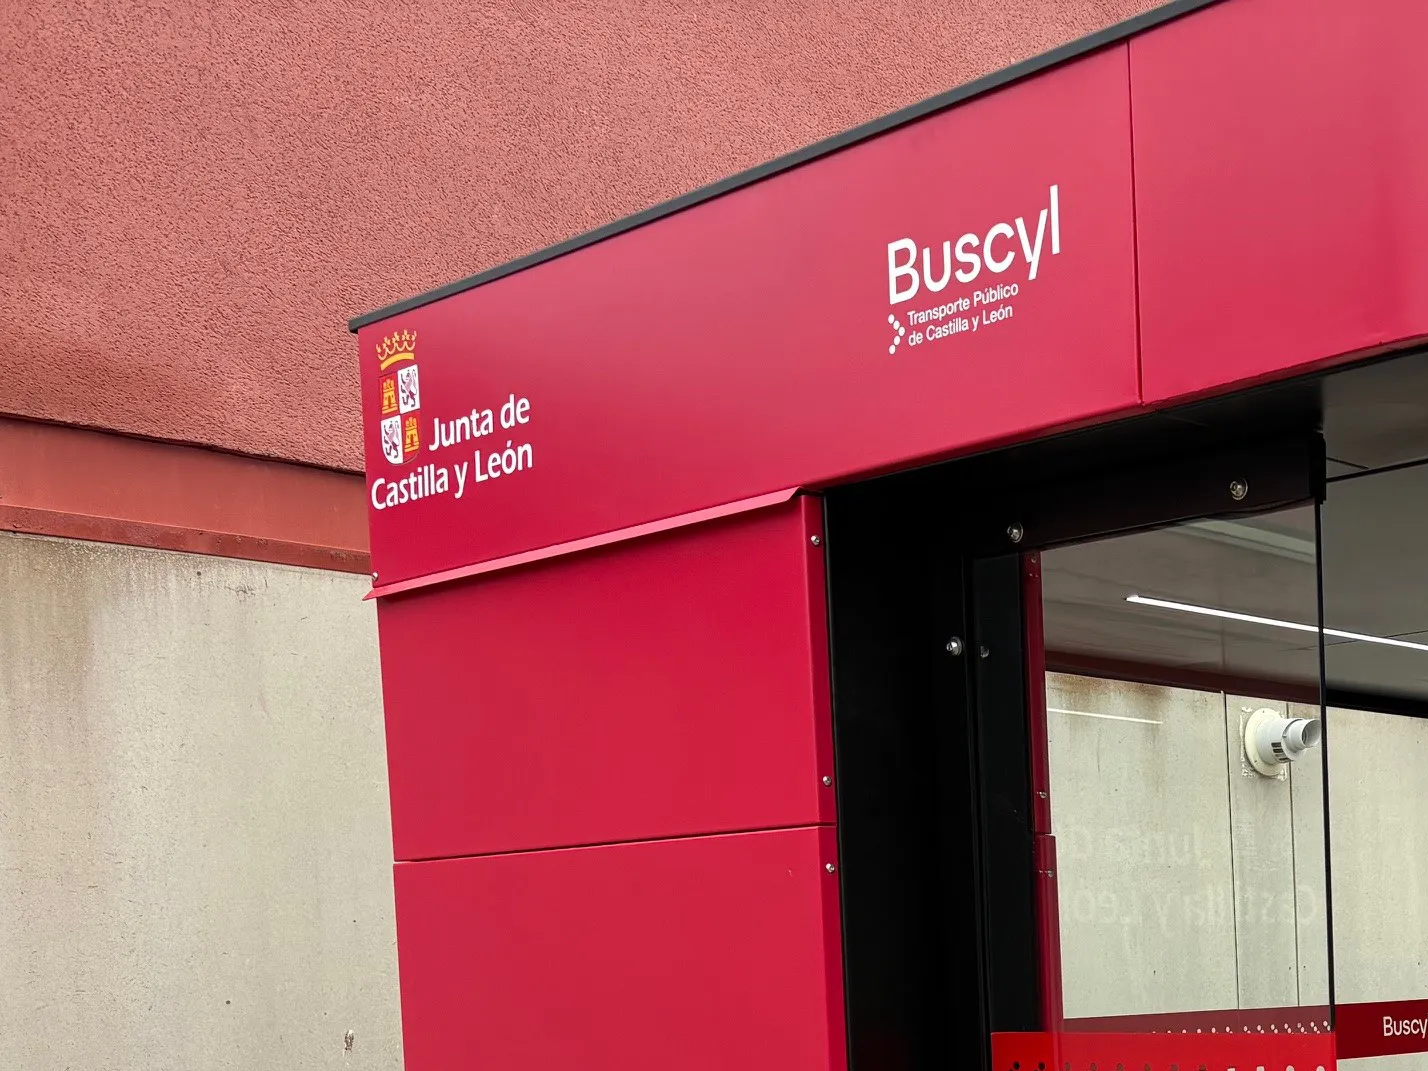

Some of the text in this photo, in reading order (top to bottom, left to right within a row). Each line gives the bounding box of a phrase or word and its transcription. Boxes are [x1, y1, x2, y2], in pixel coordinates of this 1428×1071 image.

[888, 184, 1060, 305] Buscyl
[907, 283, 1019, 326] Transporte Público
[908, 304, 1013, 346] de Castilla y León
[429, 393, 531, 451] Junta de
[371, 440, 533, 510] Castilla y León
